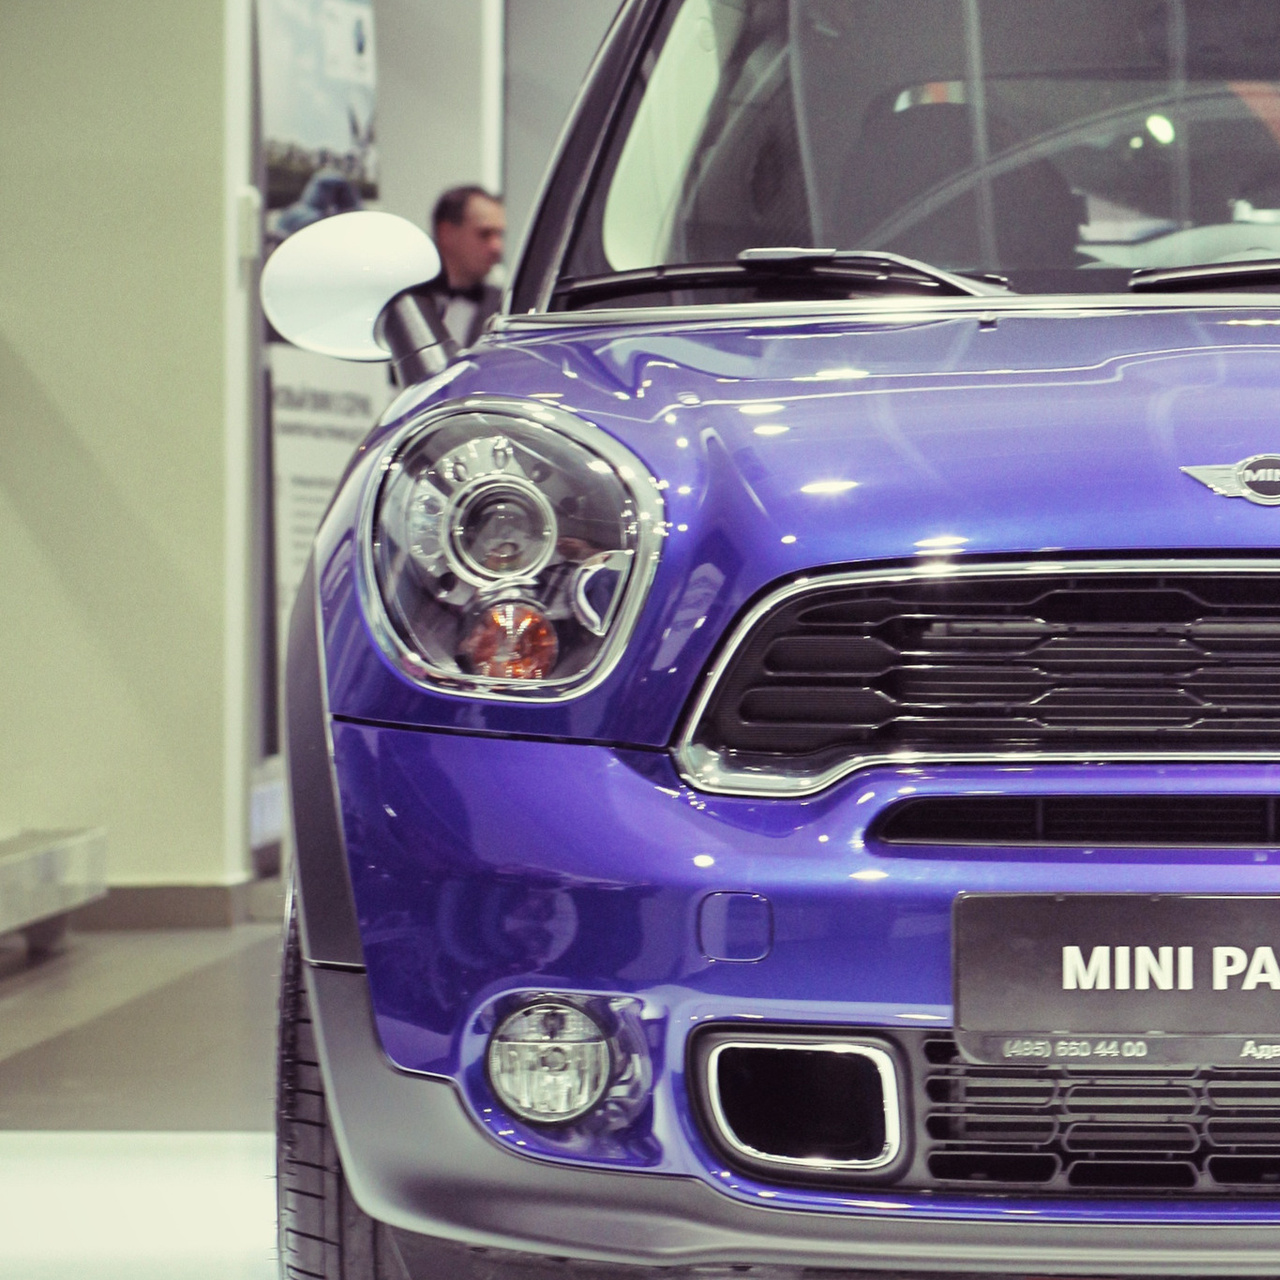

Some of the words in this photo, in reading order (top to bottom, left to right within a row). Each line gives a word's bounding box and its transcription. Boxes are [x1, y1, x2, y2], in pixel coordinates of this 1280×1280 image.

[1062, 945, 1194, 990] MINI
[1093, 1040, 1120, 1057] 44
[1121, 1040, 1148, 1057] 00
